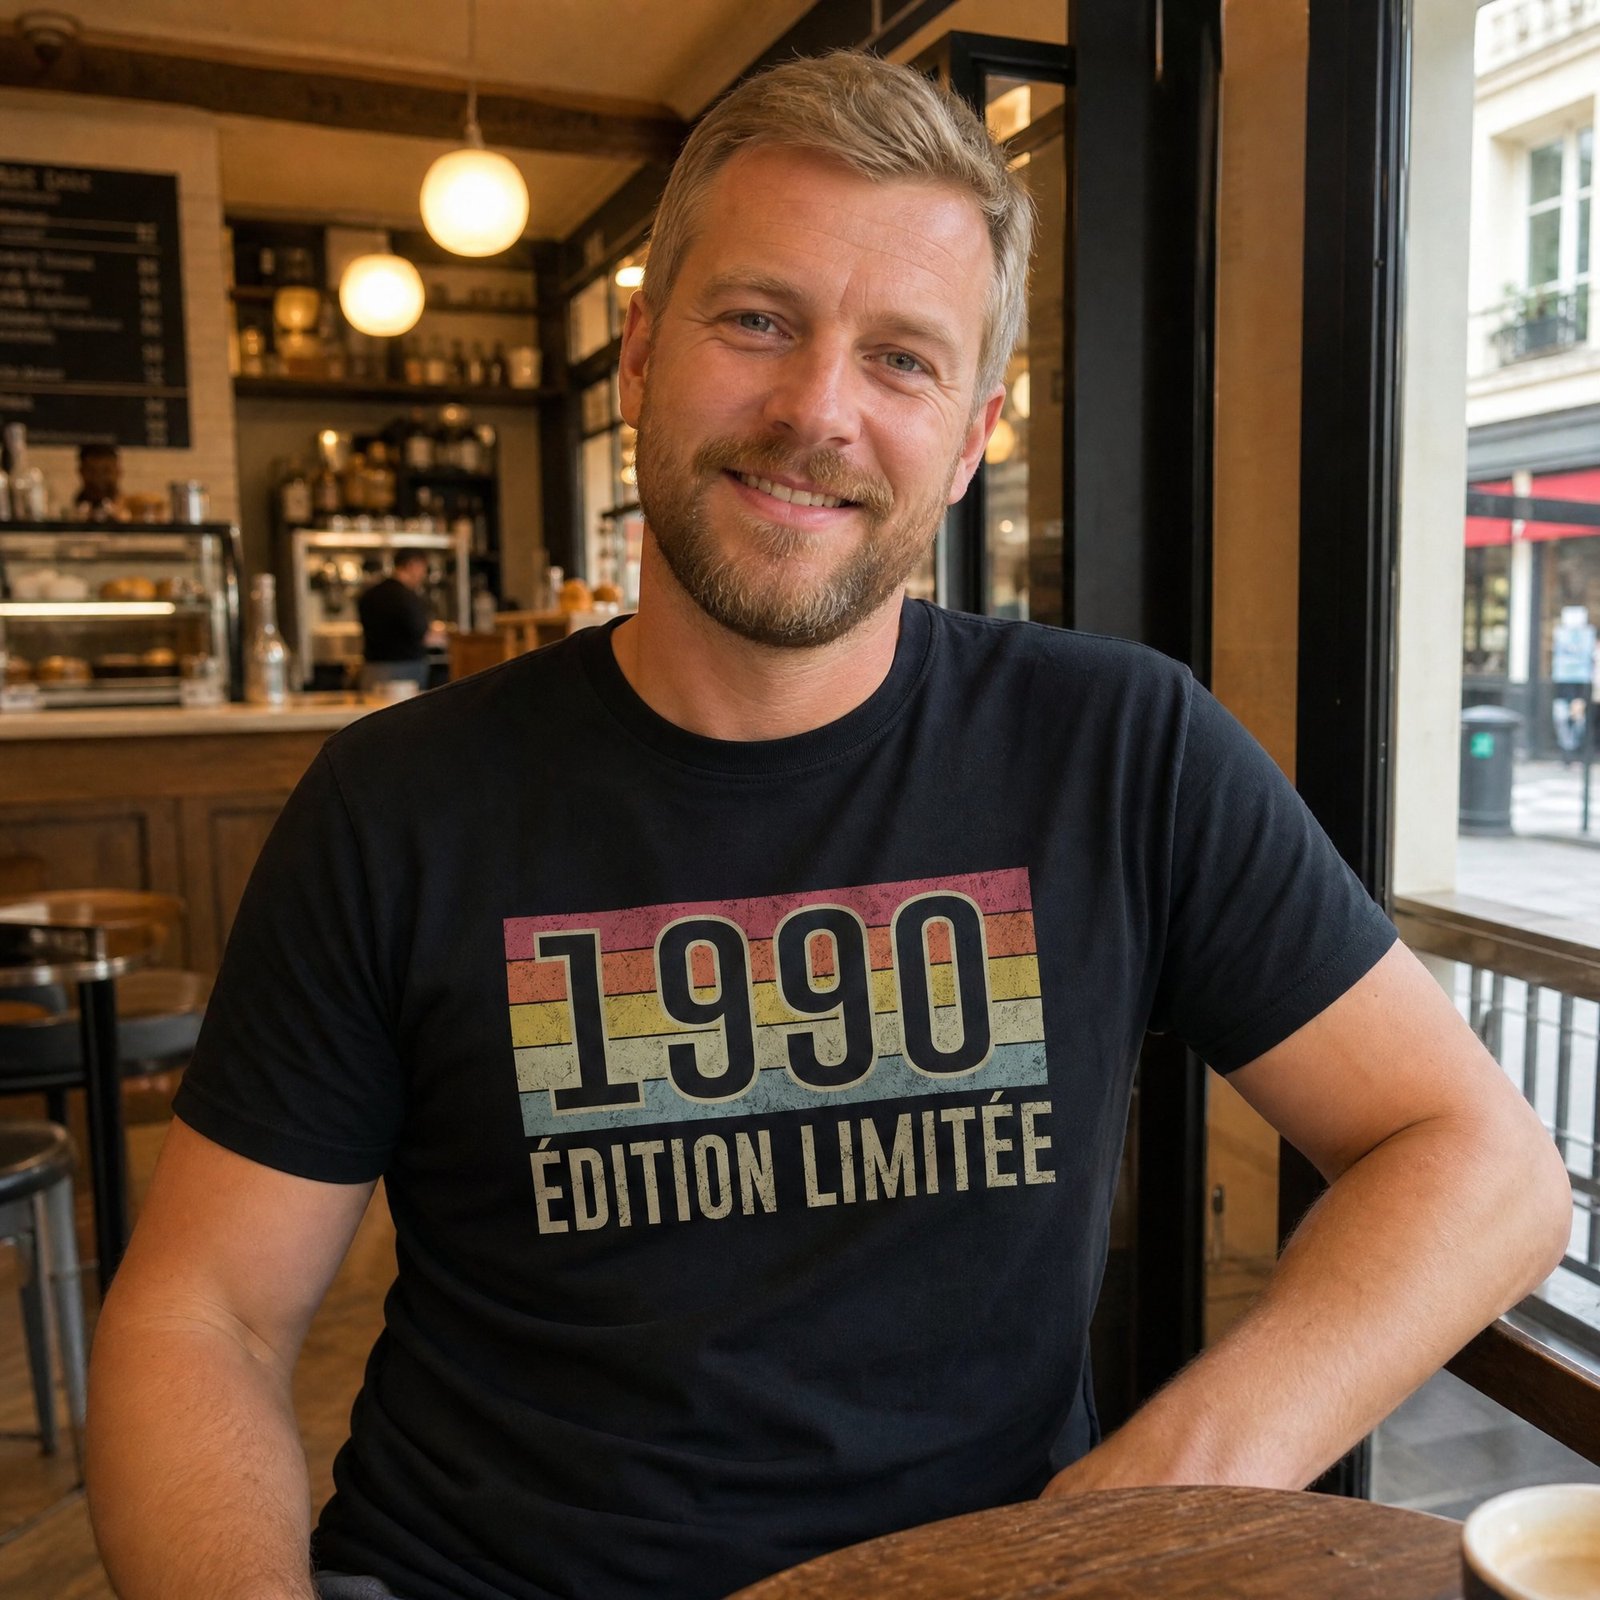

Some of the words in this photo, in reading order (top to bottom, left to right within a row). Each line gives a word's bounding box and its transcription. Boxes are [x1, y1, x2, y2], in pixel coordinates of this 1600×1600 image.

[533, 890, 994, 1116] 1990
[529, 1130, 777, 1234] ÉDITION
[801, 1091, 1056, 1208] LIMITÉE
